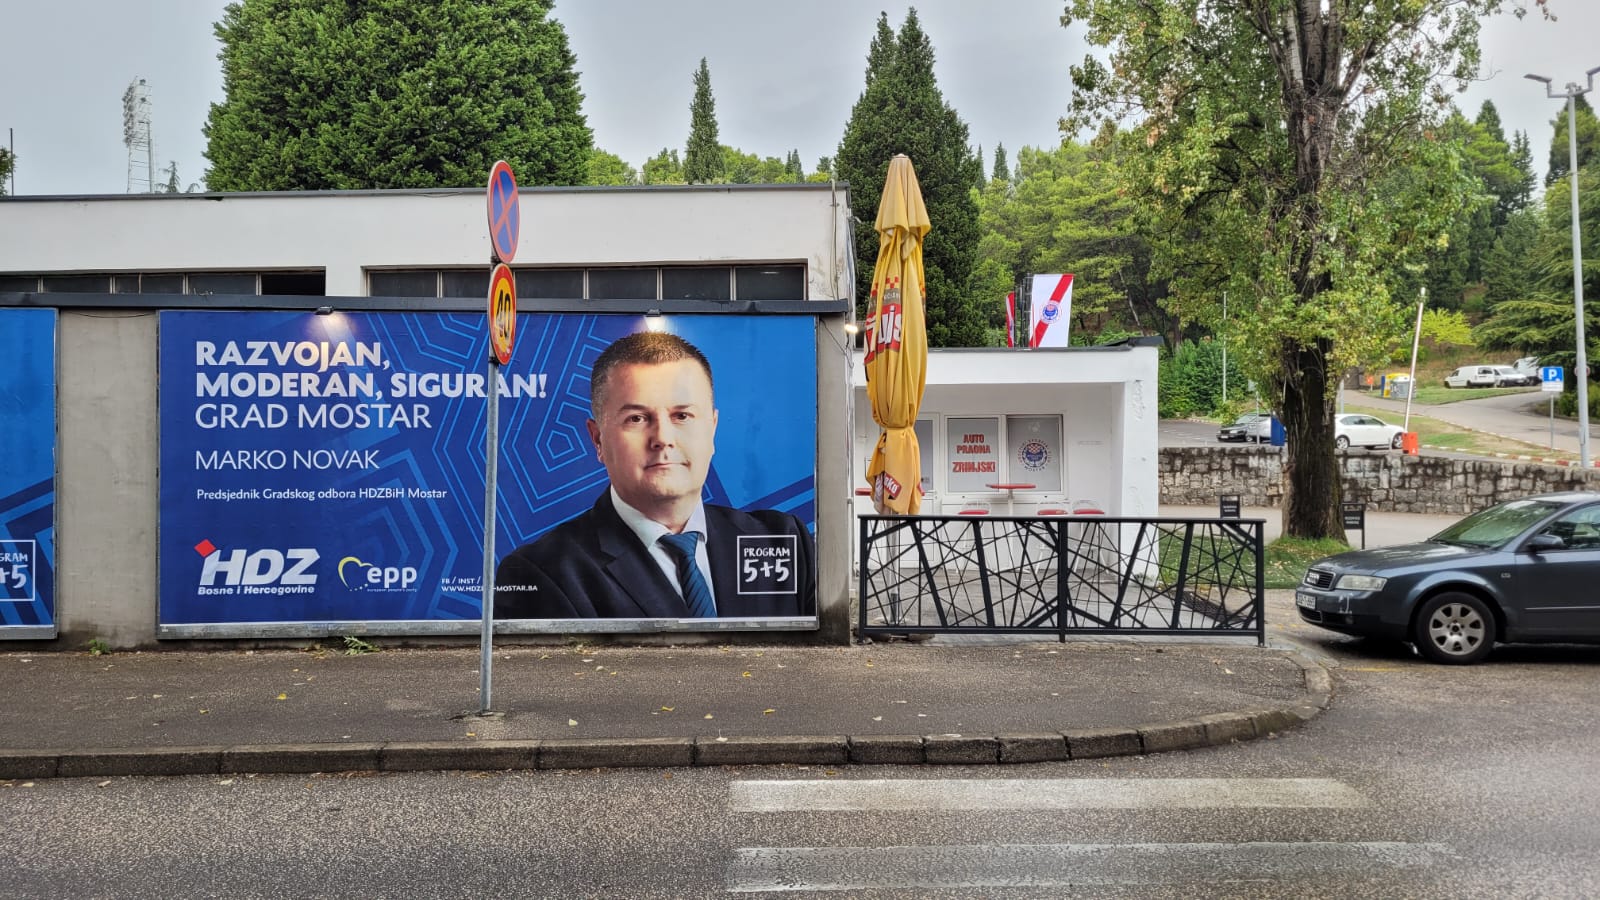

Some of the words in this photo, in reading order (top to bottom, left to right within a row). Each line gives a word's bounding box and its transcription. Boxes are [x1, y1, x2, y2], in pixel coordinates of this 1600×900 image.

[496, 290, 511, 338] 40
[196, 341, 390, 372] RAZVOJAN,
[1548, 369, 1558, 380] P
[196, 373, 383, 401] MODERAN,
[195, 404, 289, 429] GRAD
[298, 403, 432, 429] MOSTAR
[963, 434, 985, 444] AUTO
[195, 450, 287, 471] MARKO
[293, 449, 380, 470] NOVAK
[952, 461, 996, 473] ZRINJSKI
[197, 488, 260, 501] Predsjednik
[263, 488, 315, 501] Gradskog
[318, 487, 357, 499] odbora
[359, 487, 405, 499] HDZBiH
[407, 487, 447, 499] Mostar
[743, 547, 790, 557] PROGRAM
[199, 548, 321, 586] HDZ
[367, 566, 418, 589] epp
[743, 558, 791, 583] 5+5
[198, 586, 234, 596] Bosne
[236, 585, 241, 595] i
[244, 585, 315, 596] Hercegovine
